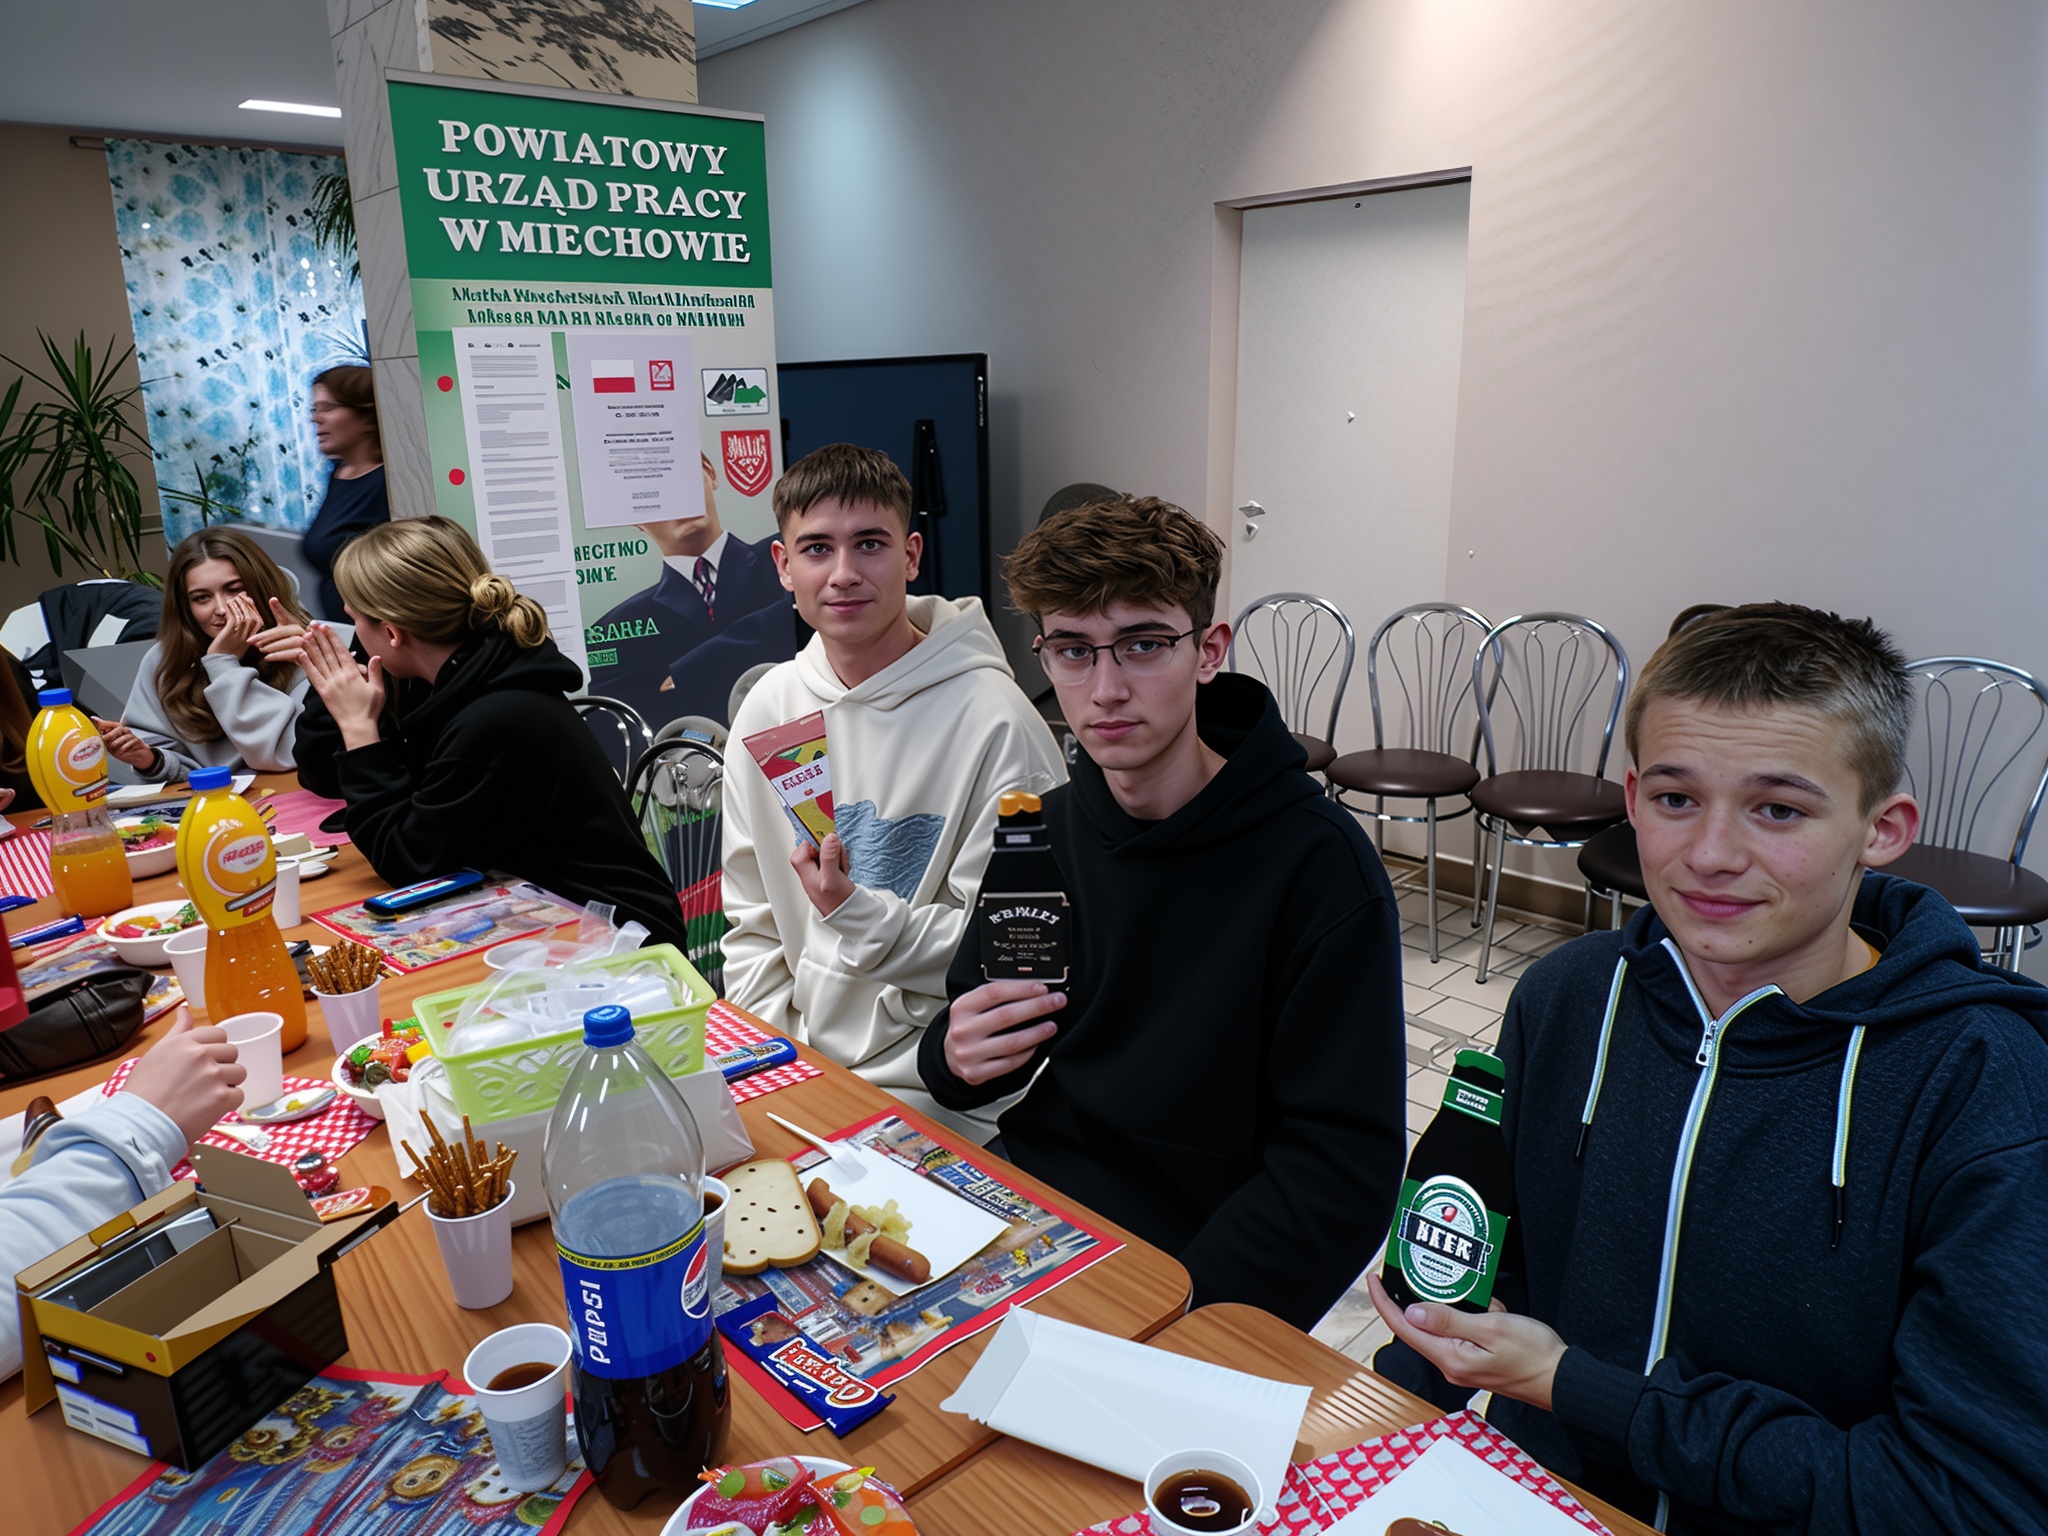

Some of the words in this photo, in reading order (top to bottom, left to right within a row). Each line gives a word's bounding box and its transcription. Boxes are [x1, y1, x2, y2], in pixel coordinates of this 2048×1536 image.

[438, 119, 728, 175] POWIATOWY
[423, 167, 598, 216] URZĄD
[606, 181, 747, 220] PRACY
[439, 216, 490, 252] W
[497, 220, 751, 263] MIECHOWIE
